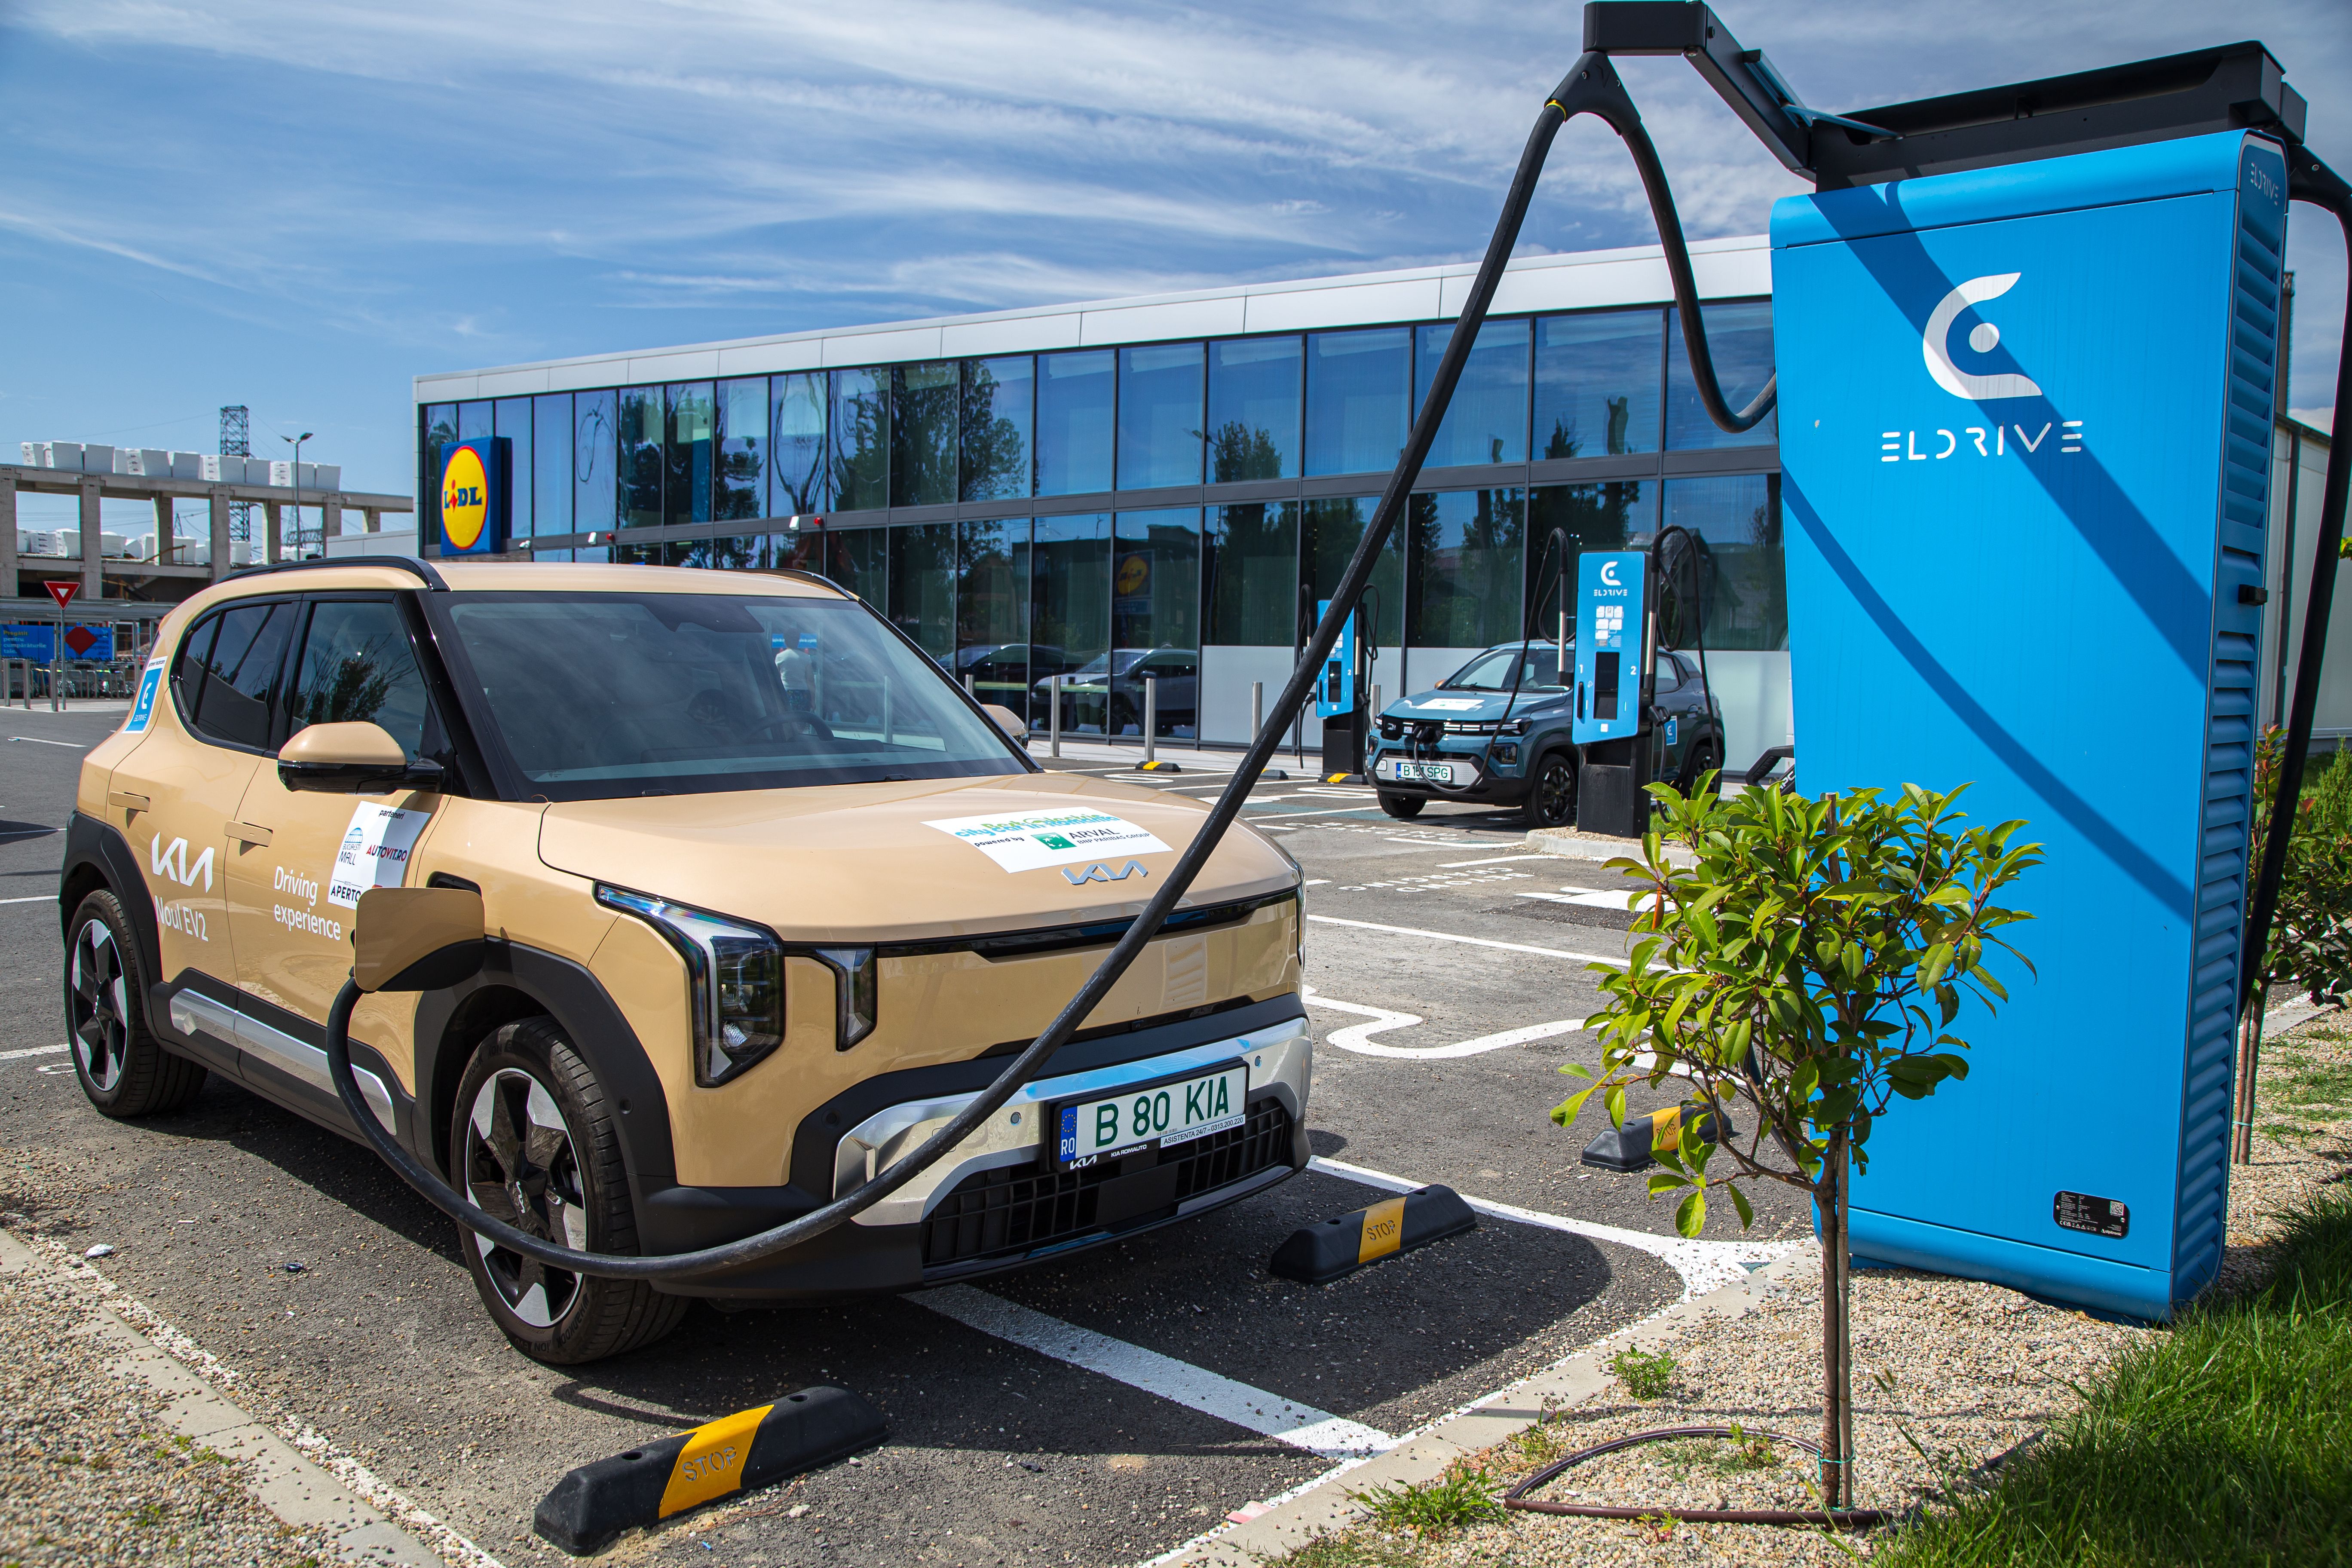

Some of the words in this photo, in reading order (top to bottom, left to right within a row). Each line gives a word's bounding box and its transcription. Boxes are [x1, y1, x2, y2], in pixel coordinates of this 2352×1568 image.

[2250, 162, 2279, 206] ELDRIVE
[1881, 421, 2083, 462] ELDRIVE
[1579, 664, 1583, 674] 1
[1630, 666, 1636, 675] 2
[1404, 766, 1410, 776] B
[1427, 767, 1448, 778] SPG
[379, 810, 405, 820] parteneri
[974, 838, 1011, 847] powered
[1069, 829, 1120, 839] ARVAL
[152, 831, 214, 893] KIA
[339, 851, 356, 865] MALL
[366, 844, 408, 862] AUTOVIT.RO
[1061, 860, 1148, 885] KIA
[274, 865, 318, 906] Driving
[154, 895, 183, 931] Noul
[183, 906, 209, 942] EV2
[274, 903, 341, 940] experience
[1095, 1103, 1119, 1148] B
[1133, 1091, 1170, 1137] 80
[1185, 1076, 1229, 1125] KIA
[1164, 1131, 1195, 1145] ASISTENTA
[1196, 1127, 1207, 1136] 24/7
[1211, 1117, 1243, 1132] 0313.200.220
[1061, 1137, 1075, 1156] RO
[1121, 1144, 1147, 1155] ROMAUTO
[1070, 1155, 1097, 1170] KIA
[1366, 1220, 1395, 1241] STOP
[682, 1446, 737, 1482] STOP
